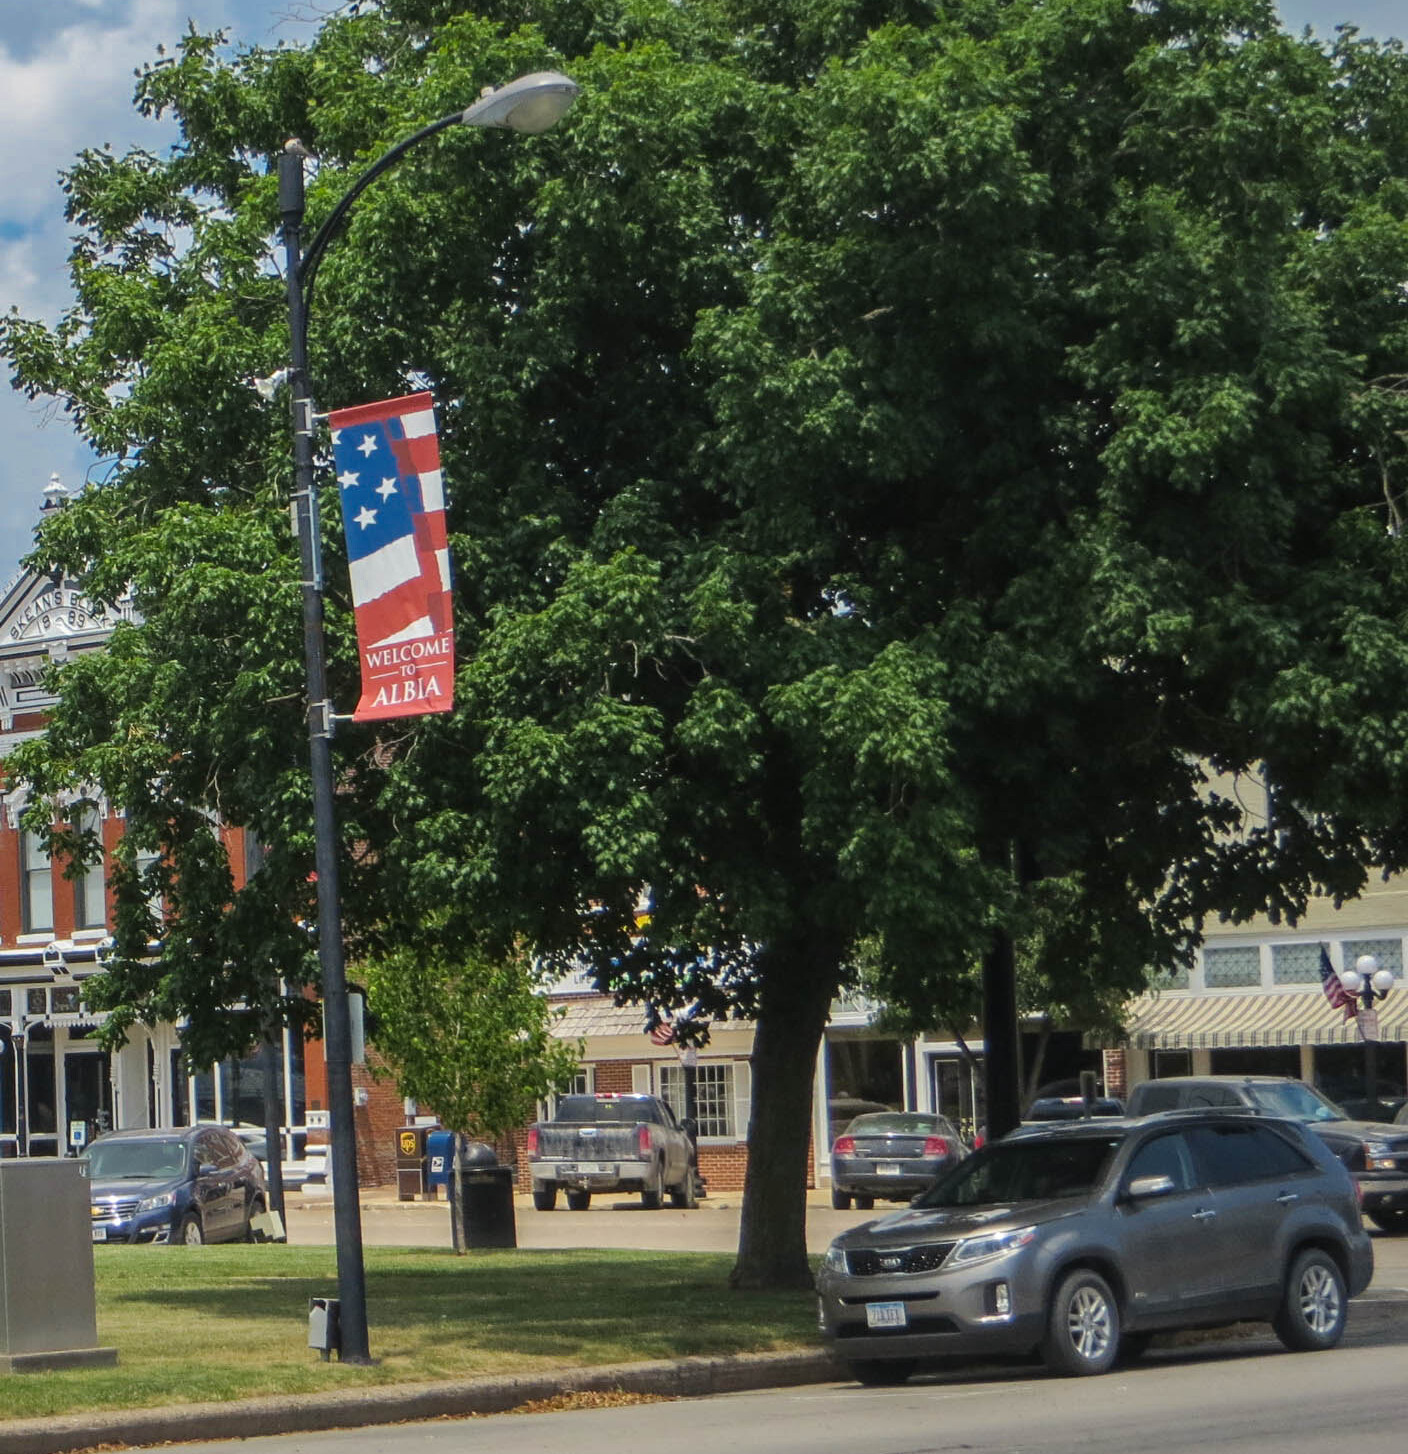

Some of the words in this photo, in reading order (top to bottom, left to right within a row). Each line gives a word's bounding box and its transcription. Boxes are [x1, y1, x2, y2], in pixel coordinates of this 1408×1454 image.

[10, 591, 63, 638] SKEANS
[365, 637, 451, 669] WELCOME
[400, 663, 416, 677] TO
[370, 675, 443, 708] ALBIA
